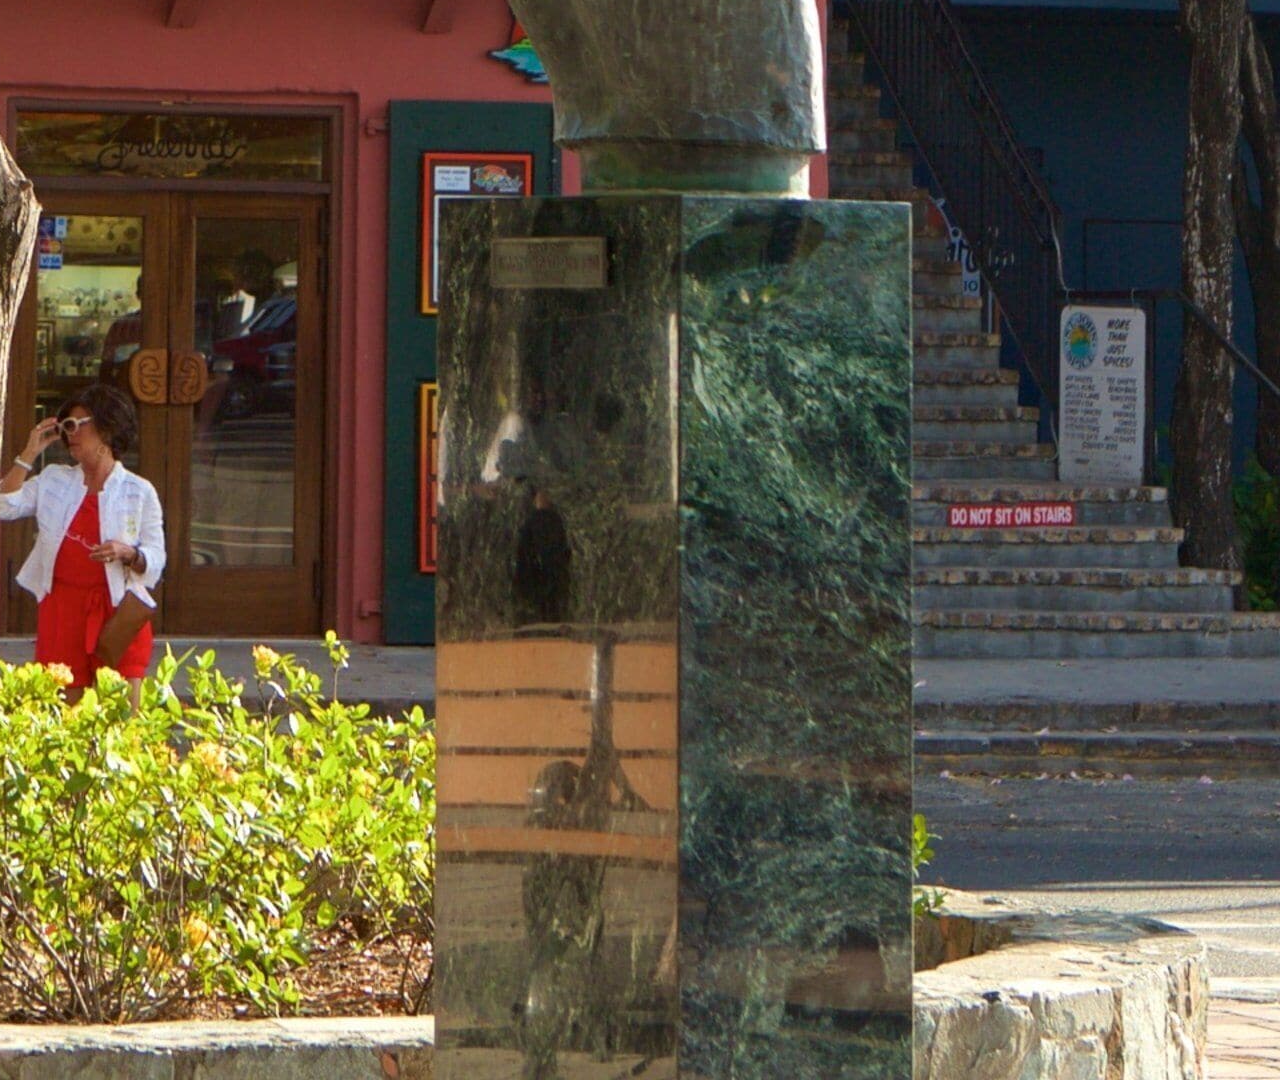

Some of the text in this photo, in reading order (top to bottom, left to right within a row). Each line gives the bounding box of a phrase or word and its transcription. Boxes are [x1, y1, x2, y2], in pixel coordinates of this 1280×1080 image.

[1106, 318, 1132, 330] MORE
[1107, 331, 1129, 342] THAN
[951, 505, 1073, 525] DO NOT SIT ON STAIRS
